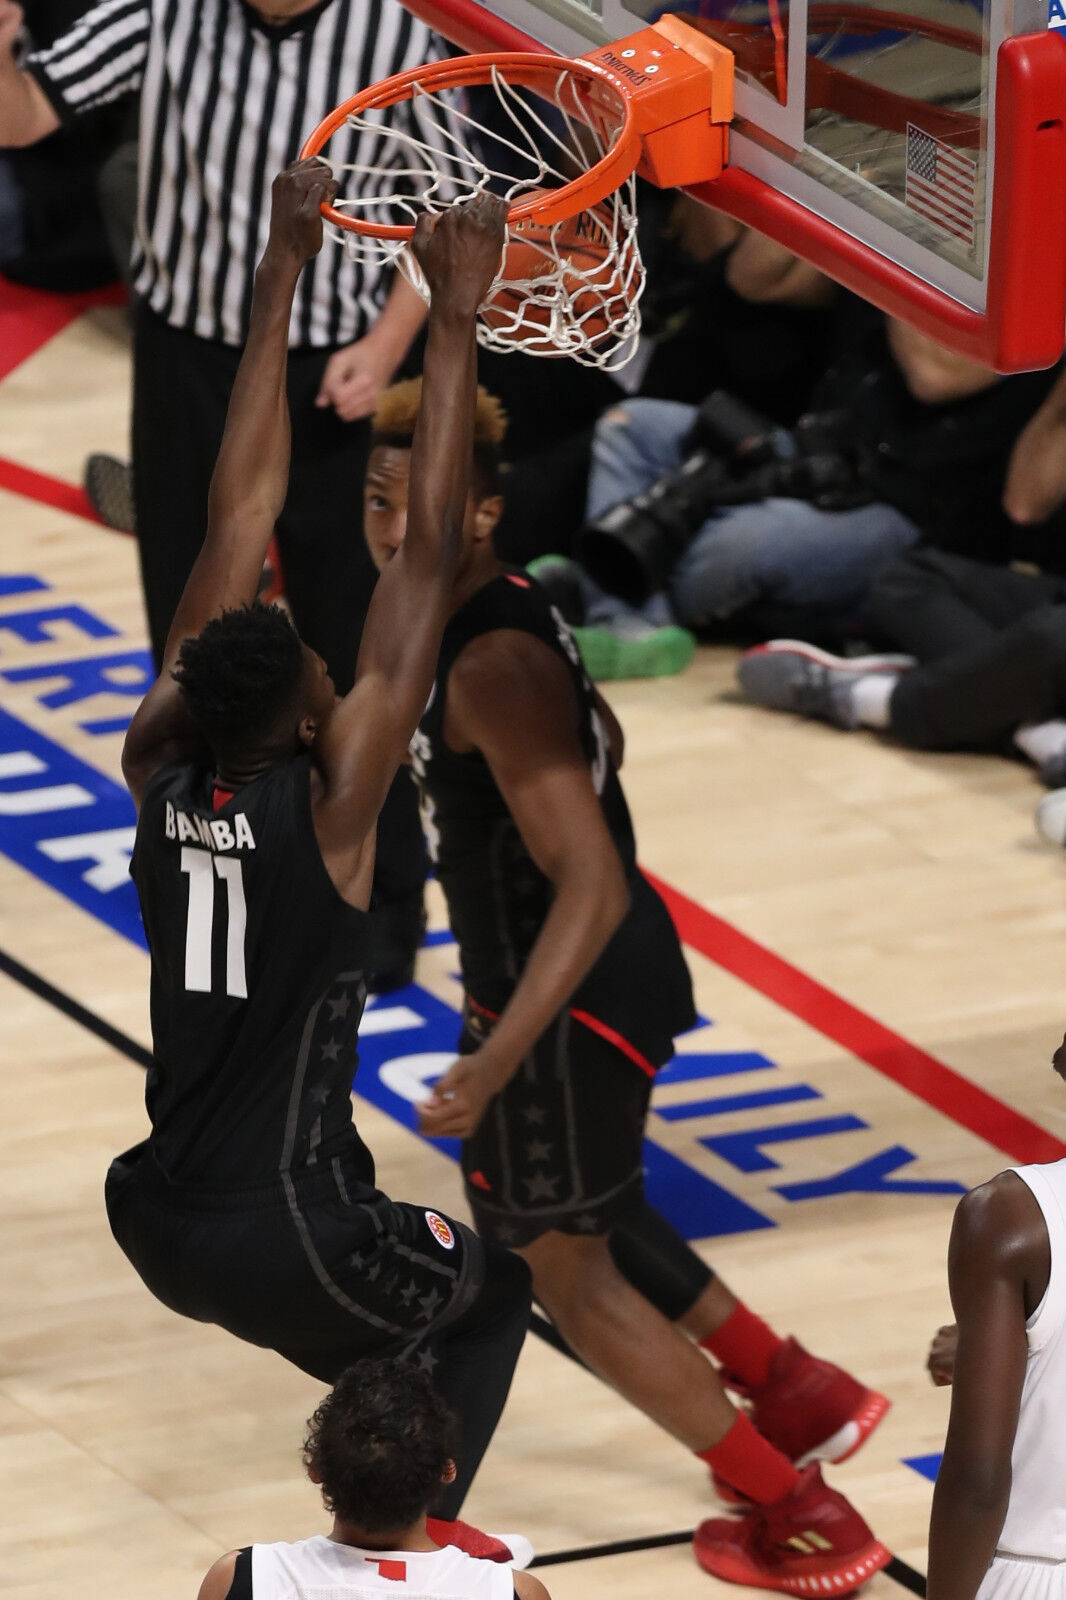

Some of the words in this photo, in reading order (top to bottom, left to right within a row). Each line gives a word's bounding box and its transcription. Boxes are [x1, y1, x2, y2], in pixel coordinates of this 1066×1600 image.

[598, 52, 652, 87] SPALDING
[165, 800, 256, 852] BAMBA
[181, 846, 248, 999] 11
